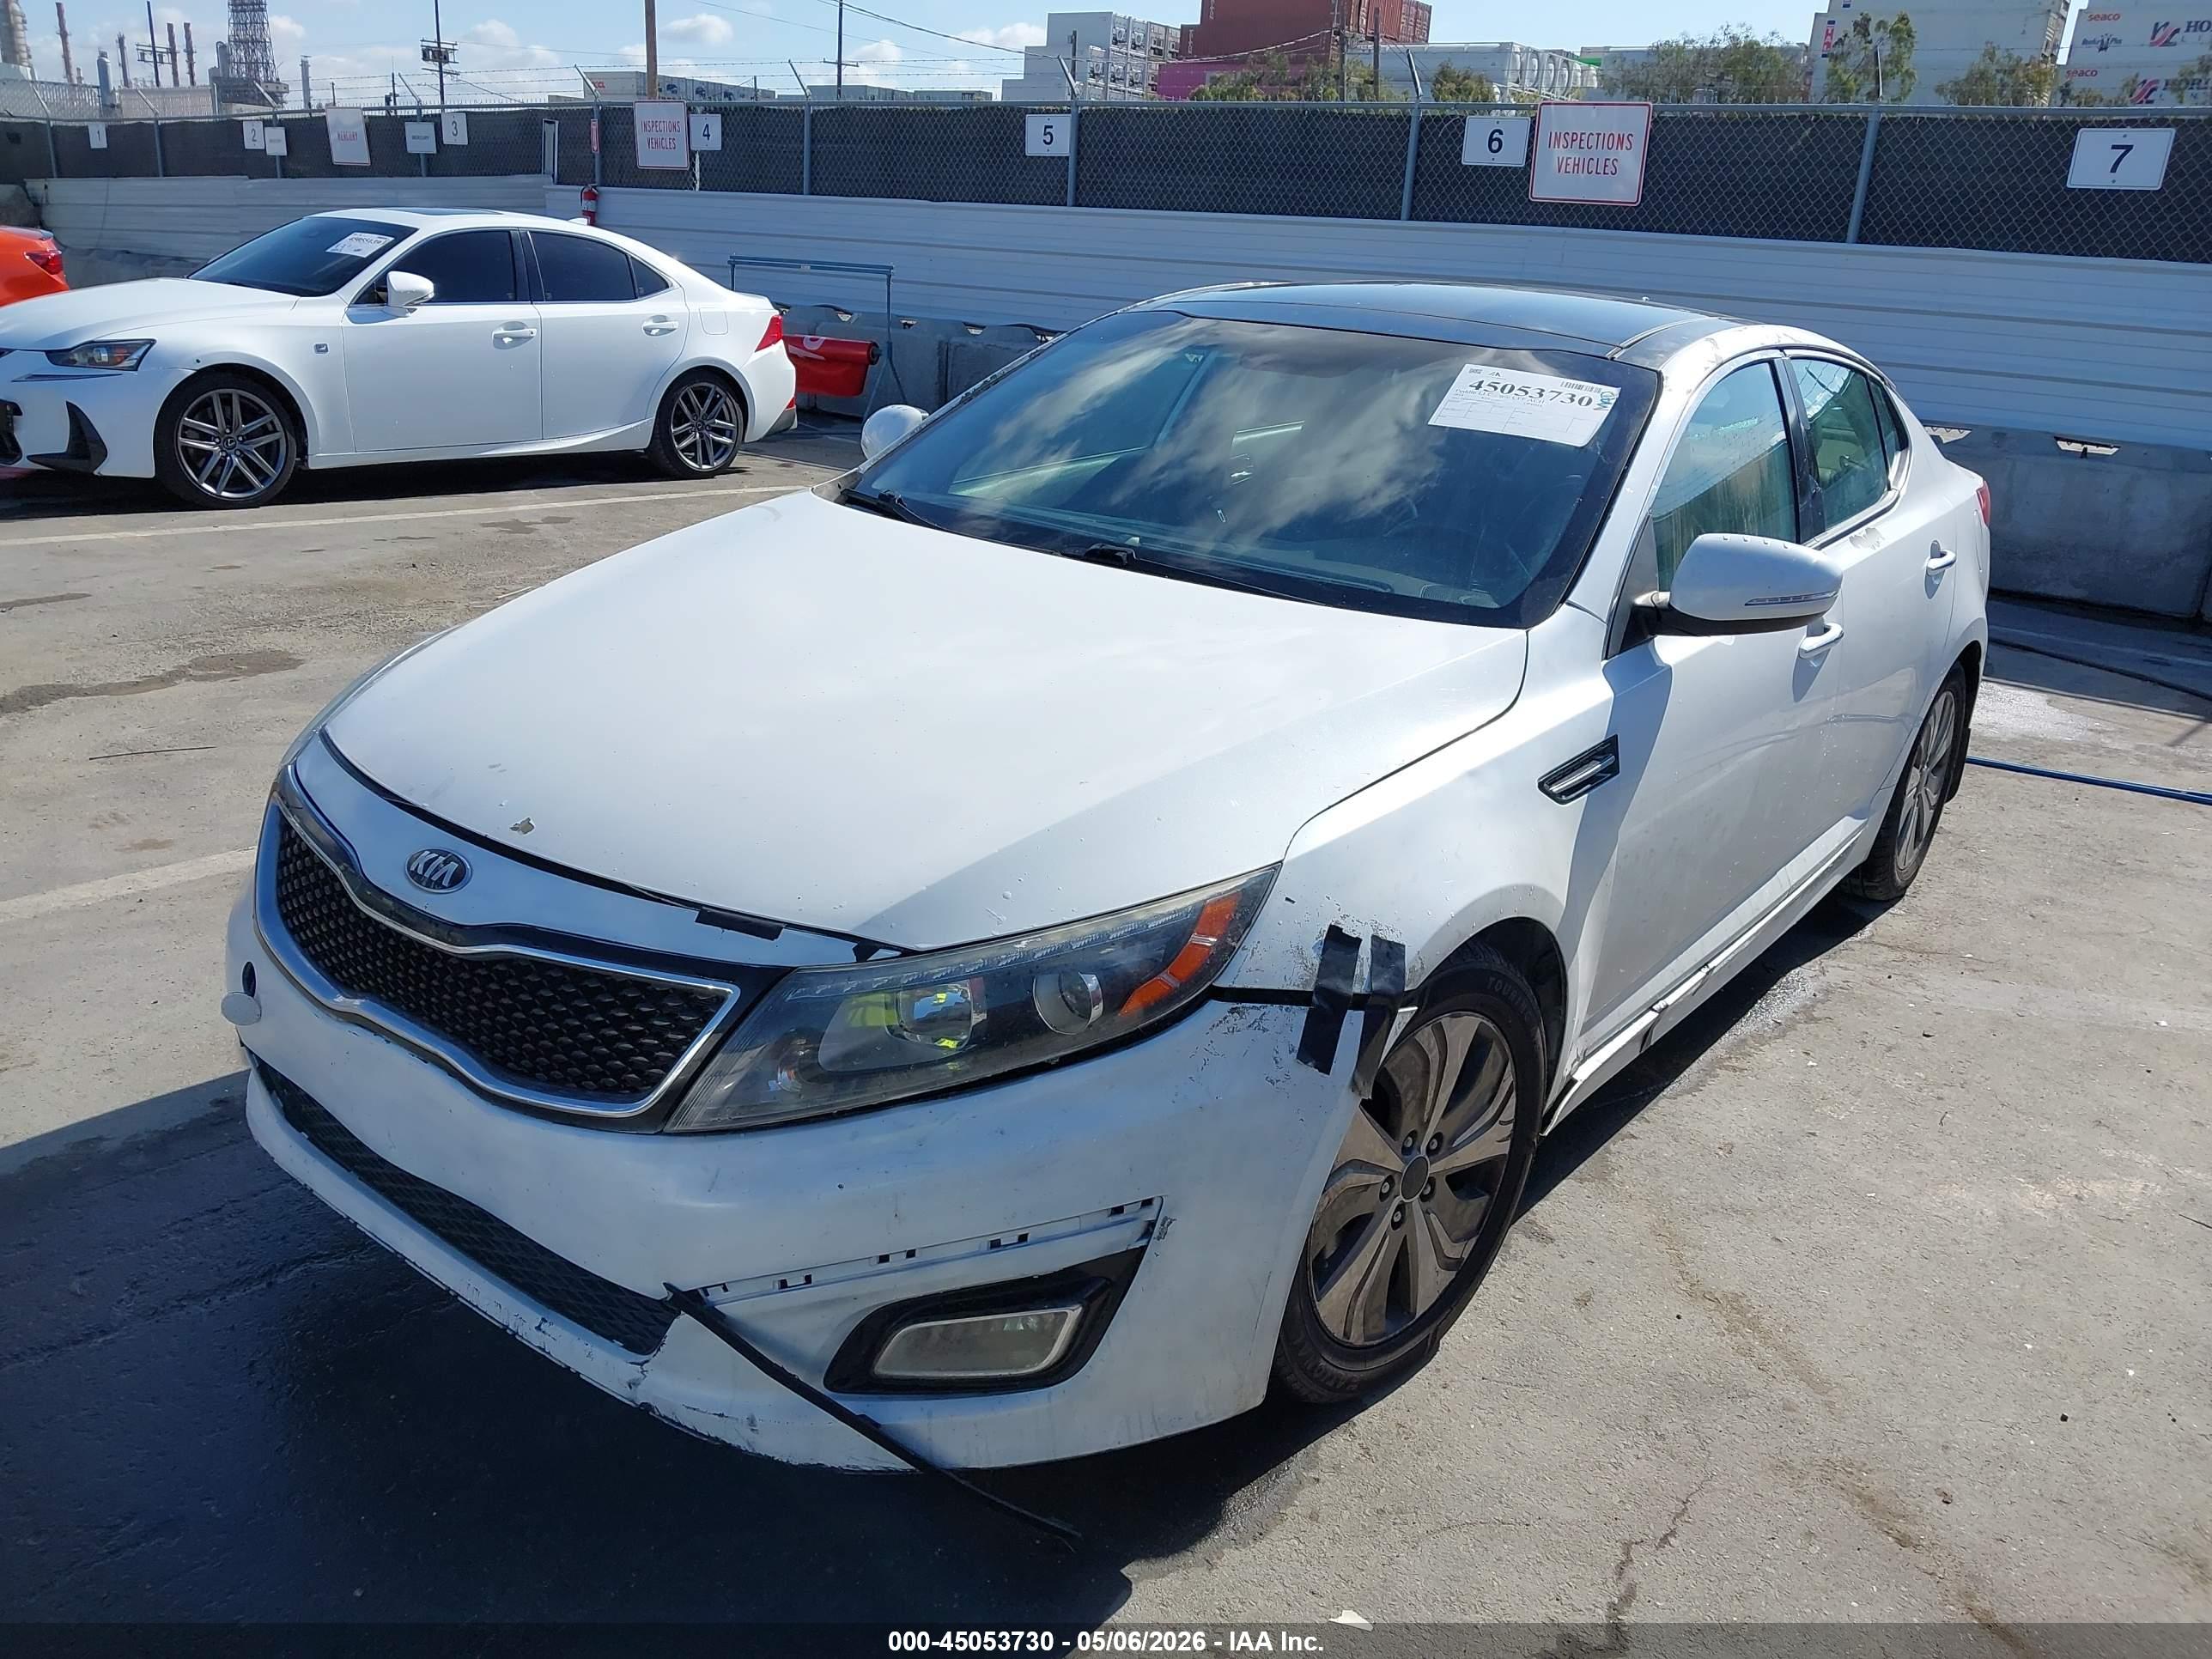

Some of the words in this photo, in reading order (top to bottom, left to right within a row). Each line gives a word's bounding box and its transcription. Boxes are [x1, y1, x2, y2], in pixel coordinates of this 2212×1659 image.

[2087, 13, 2121, 21] seaco
[2066, 68, 2099, 78] seaco
[250, 128, 257, 143] 2
[452, 120, 459, 137] 3
[641, 120, 681, 133] INSPECTIONS
[702, 123, 711, 142] 4
[1042, 125, 1054, 146] 5
[647, 137, 677, 150] VEHICLES
[1487, 128, 1504, 154] 6
[1548, 131, 1634, 151] INSPECTIONS
[1557, 156, 1619, 176] VEHICLES
[2109, 144, 2135, 173] 7
[1468, 379, 1594, 408] 45053730
[410, 850, 459, 888] KIA
